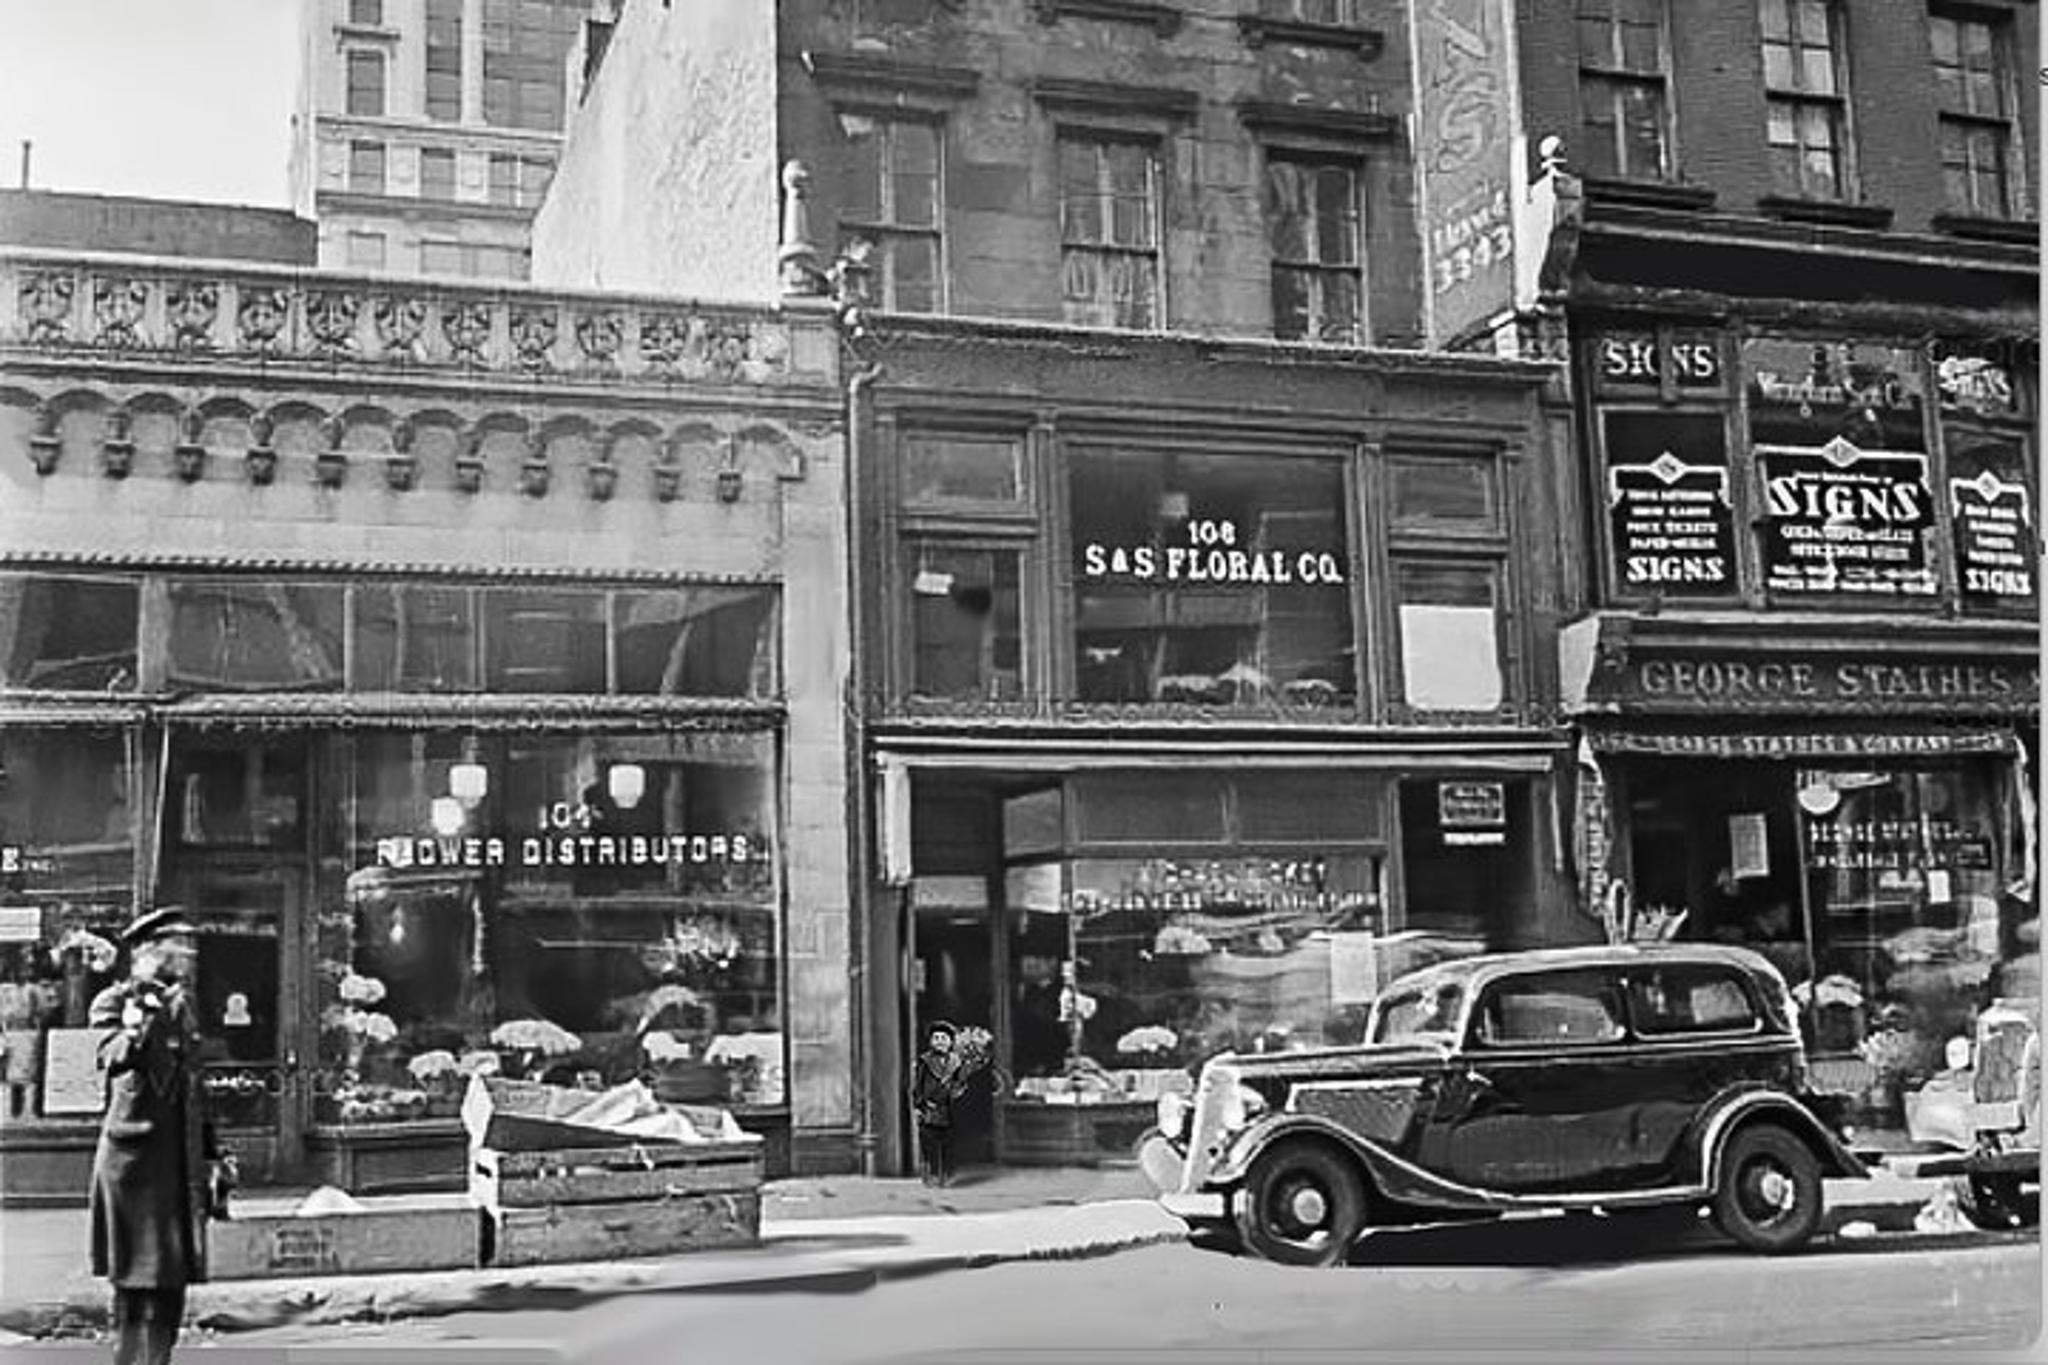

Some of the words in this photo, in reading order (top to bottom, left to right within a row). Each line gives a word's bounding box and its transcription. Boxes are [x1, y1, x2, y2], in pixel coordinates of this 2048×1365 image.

[1769, 476, 1921, 524] SIGNS
[1165, 548, 1292, 584] FLORAL
[1626, 556, 1725, 583] SIGNS
[1640, 660, 1818, 697] GEORGE
[522, 835, 748, 866] DISTRIBUTORS
